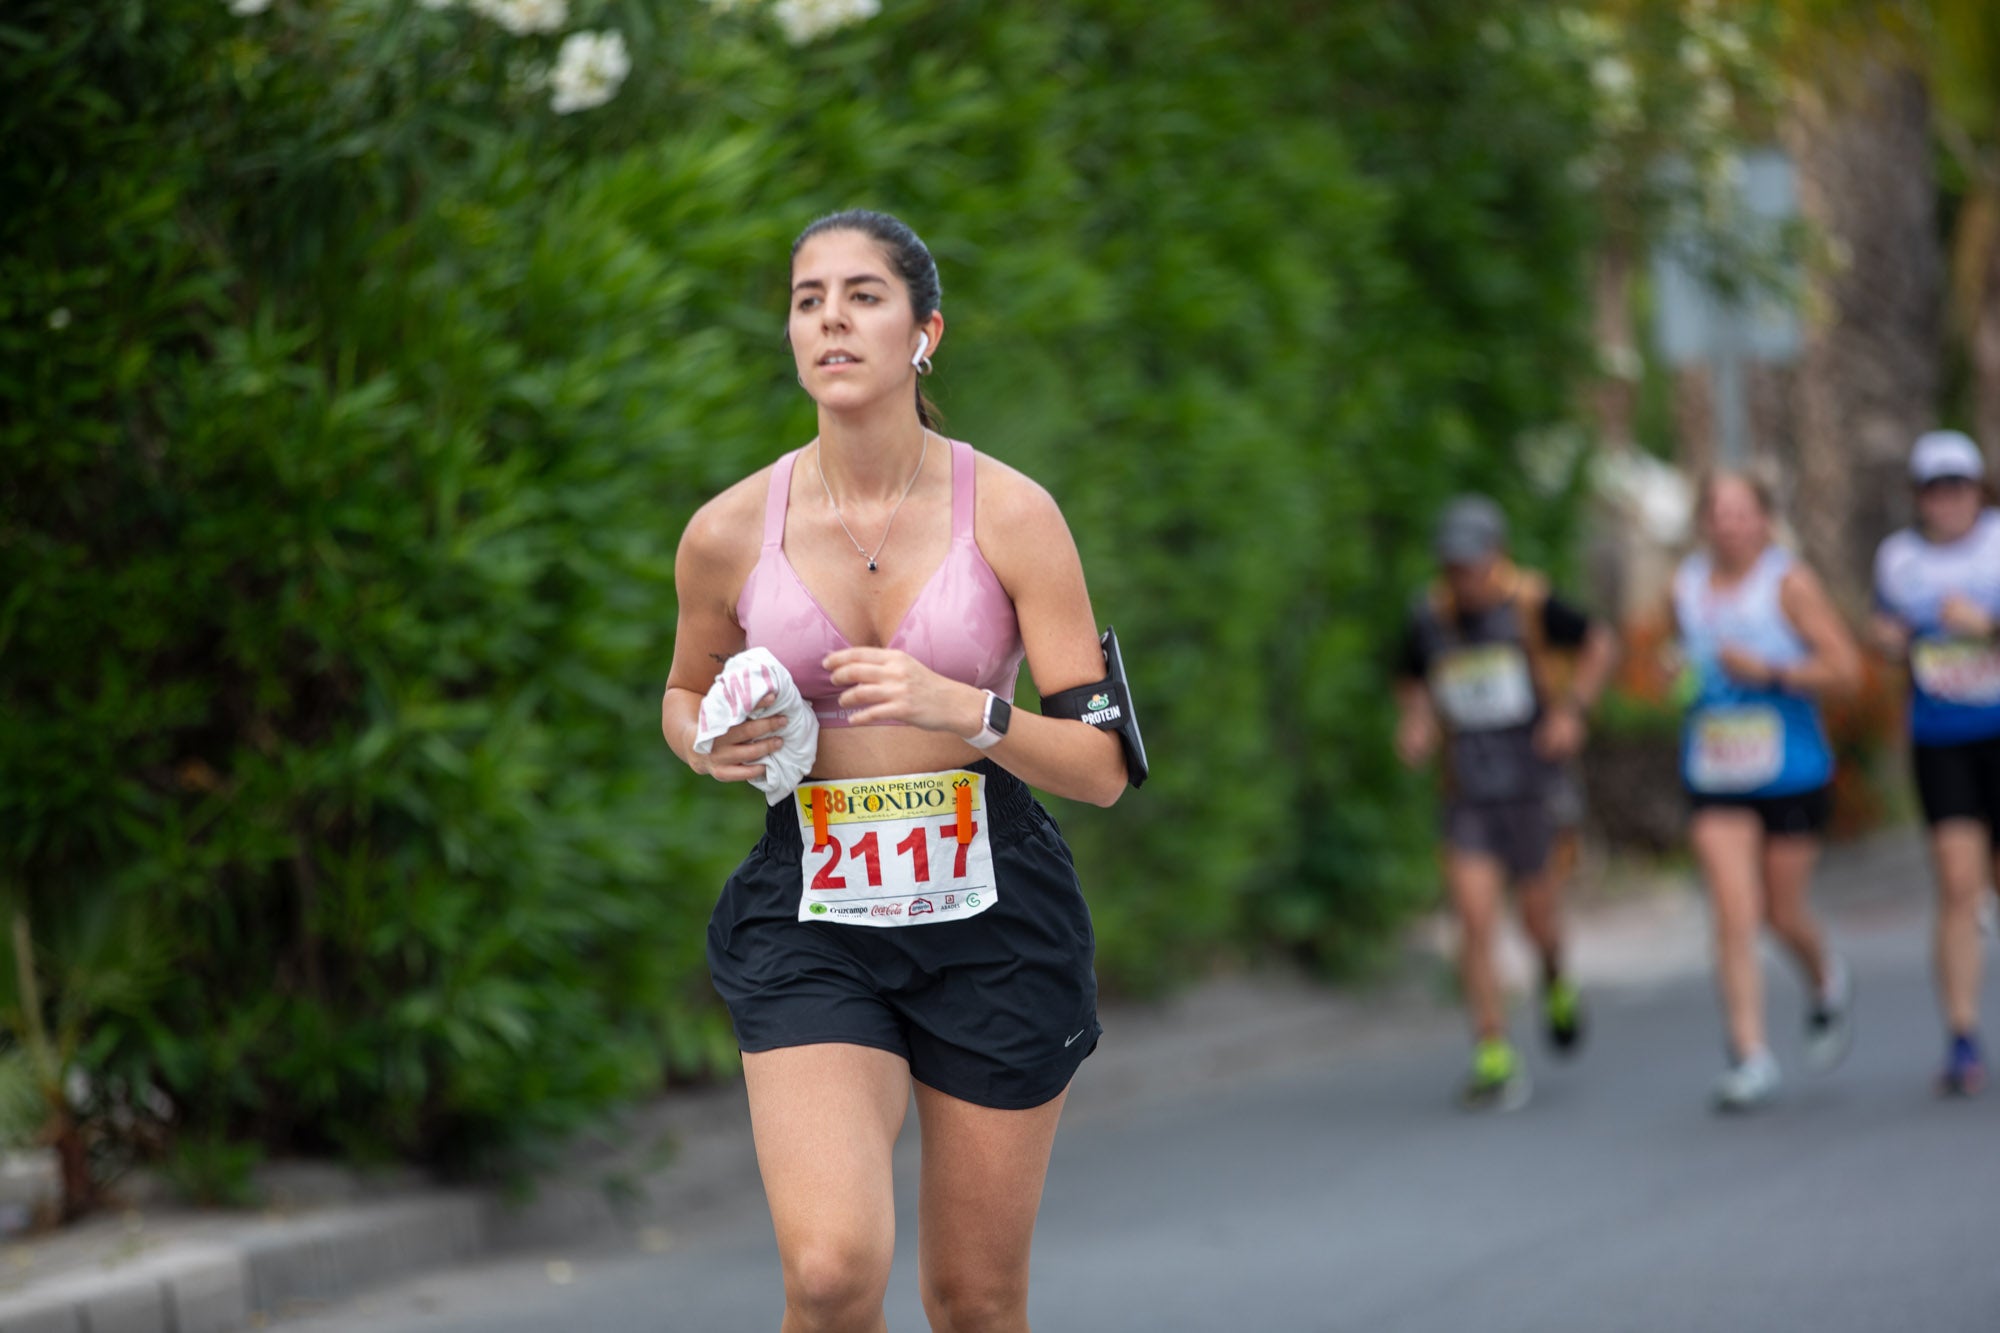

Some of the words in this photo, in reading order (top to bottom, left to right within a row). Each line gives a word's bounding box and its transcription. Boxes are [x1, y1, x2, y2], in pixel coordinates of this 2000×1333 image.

[1081, 705, 1121, 724] PROTEIN
[851, 785, 886, 795] GRAN
[888, 780, 936, 792] PREMIO
[848, 789, 945, 814] FONDO
[811, 821, 978, 890] 2117
[830, 906, 868, 915] Cruzcampo
